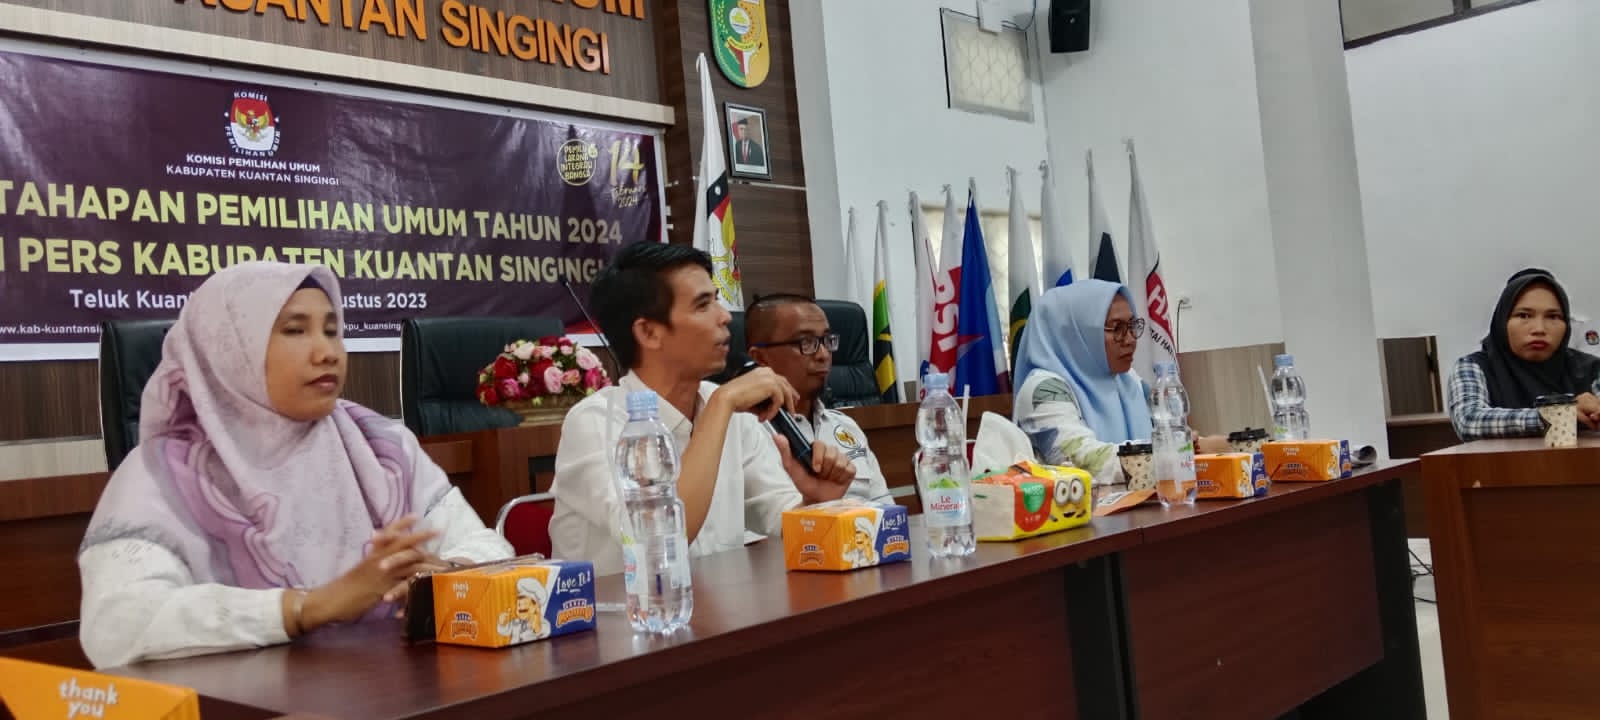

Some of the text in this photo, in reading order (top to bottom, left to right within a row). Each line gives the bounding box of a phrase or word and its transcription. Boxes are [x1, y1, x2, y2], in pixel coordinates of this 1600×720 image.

[172, 0, 610, 75] NTAN SINGINGI
[234, 91, 268, 102] KOMISI
[186, 154, 320, 173] KOMISI PEMILIHAN UMUM
[607, 138, 645, 187] 14
[166, 165, 339, 186] KABUPATEN KUANTAN SINGINGI
[0, 180, 622, 245] TAHAPAN PEMILIHAN UMUM TAHUN 2024
[18, 237, 122, 275] PERS
[354, 249, 493, 282] KUANTAN
[69, 288, 130, 309] Teluk
[387, 292, 428, 309] 2023
[940, 495, 951, 504] Le
[555, 576, 576, 595] Love
[58, 676, 119, 705] thank
[66, 701, 105, 719] you
